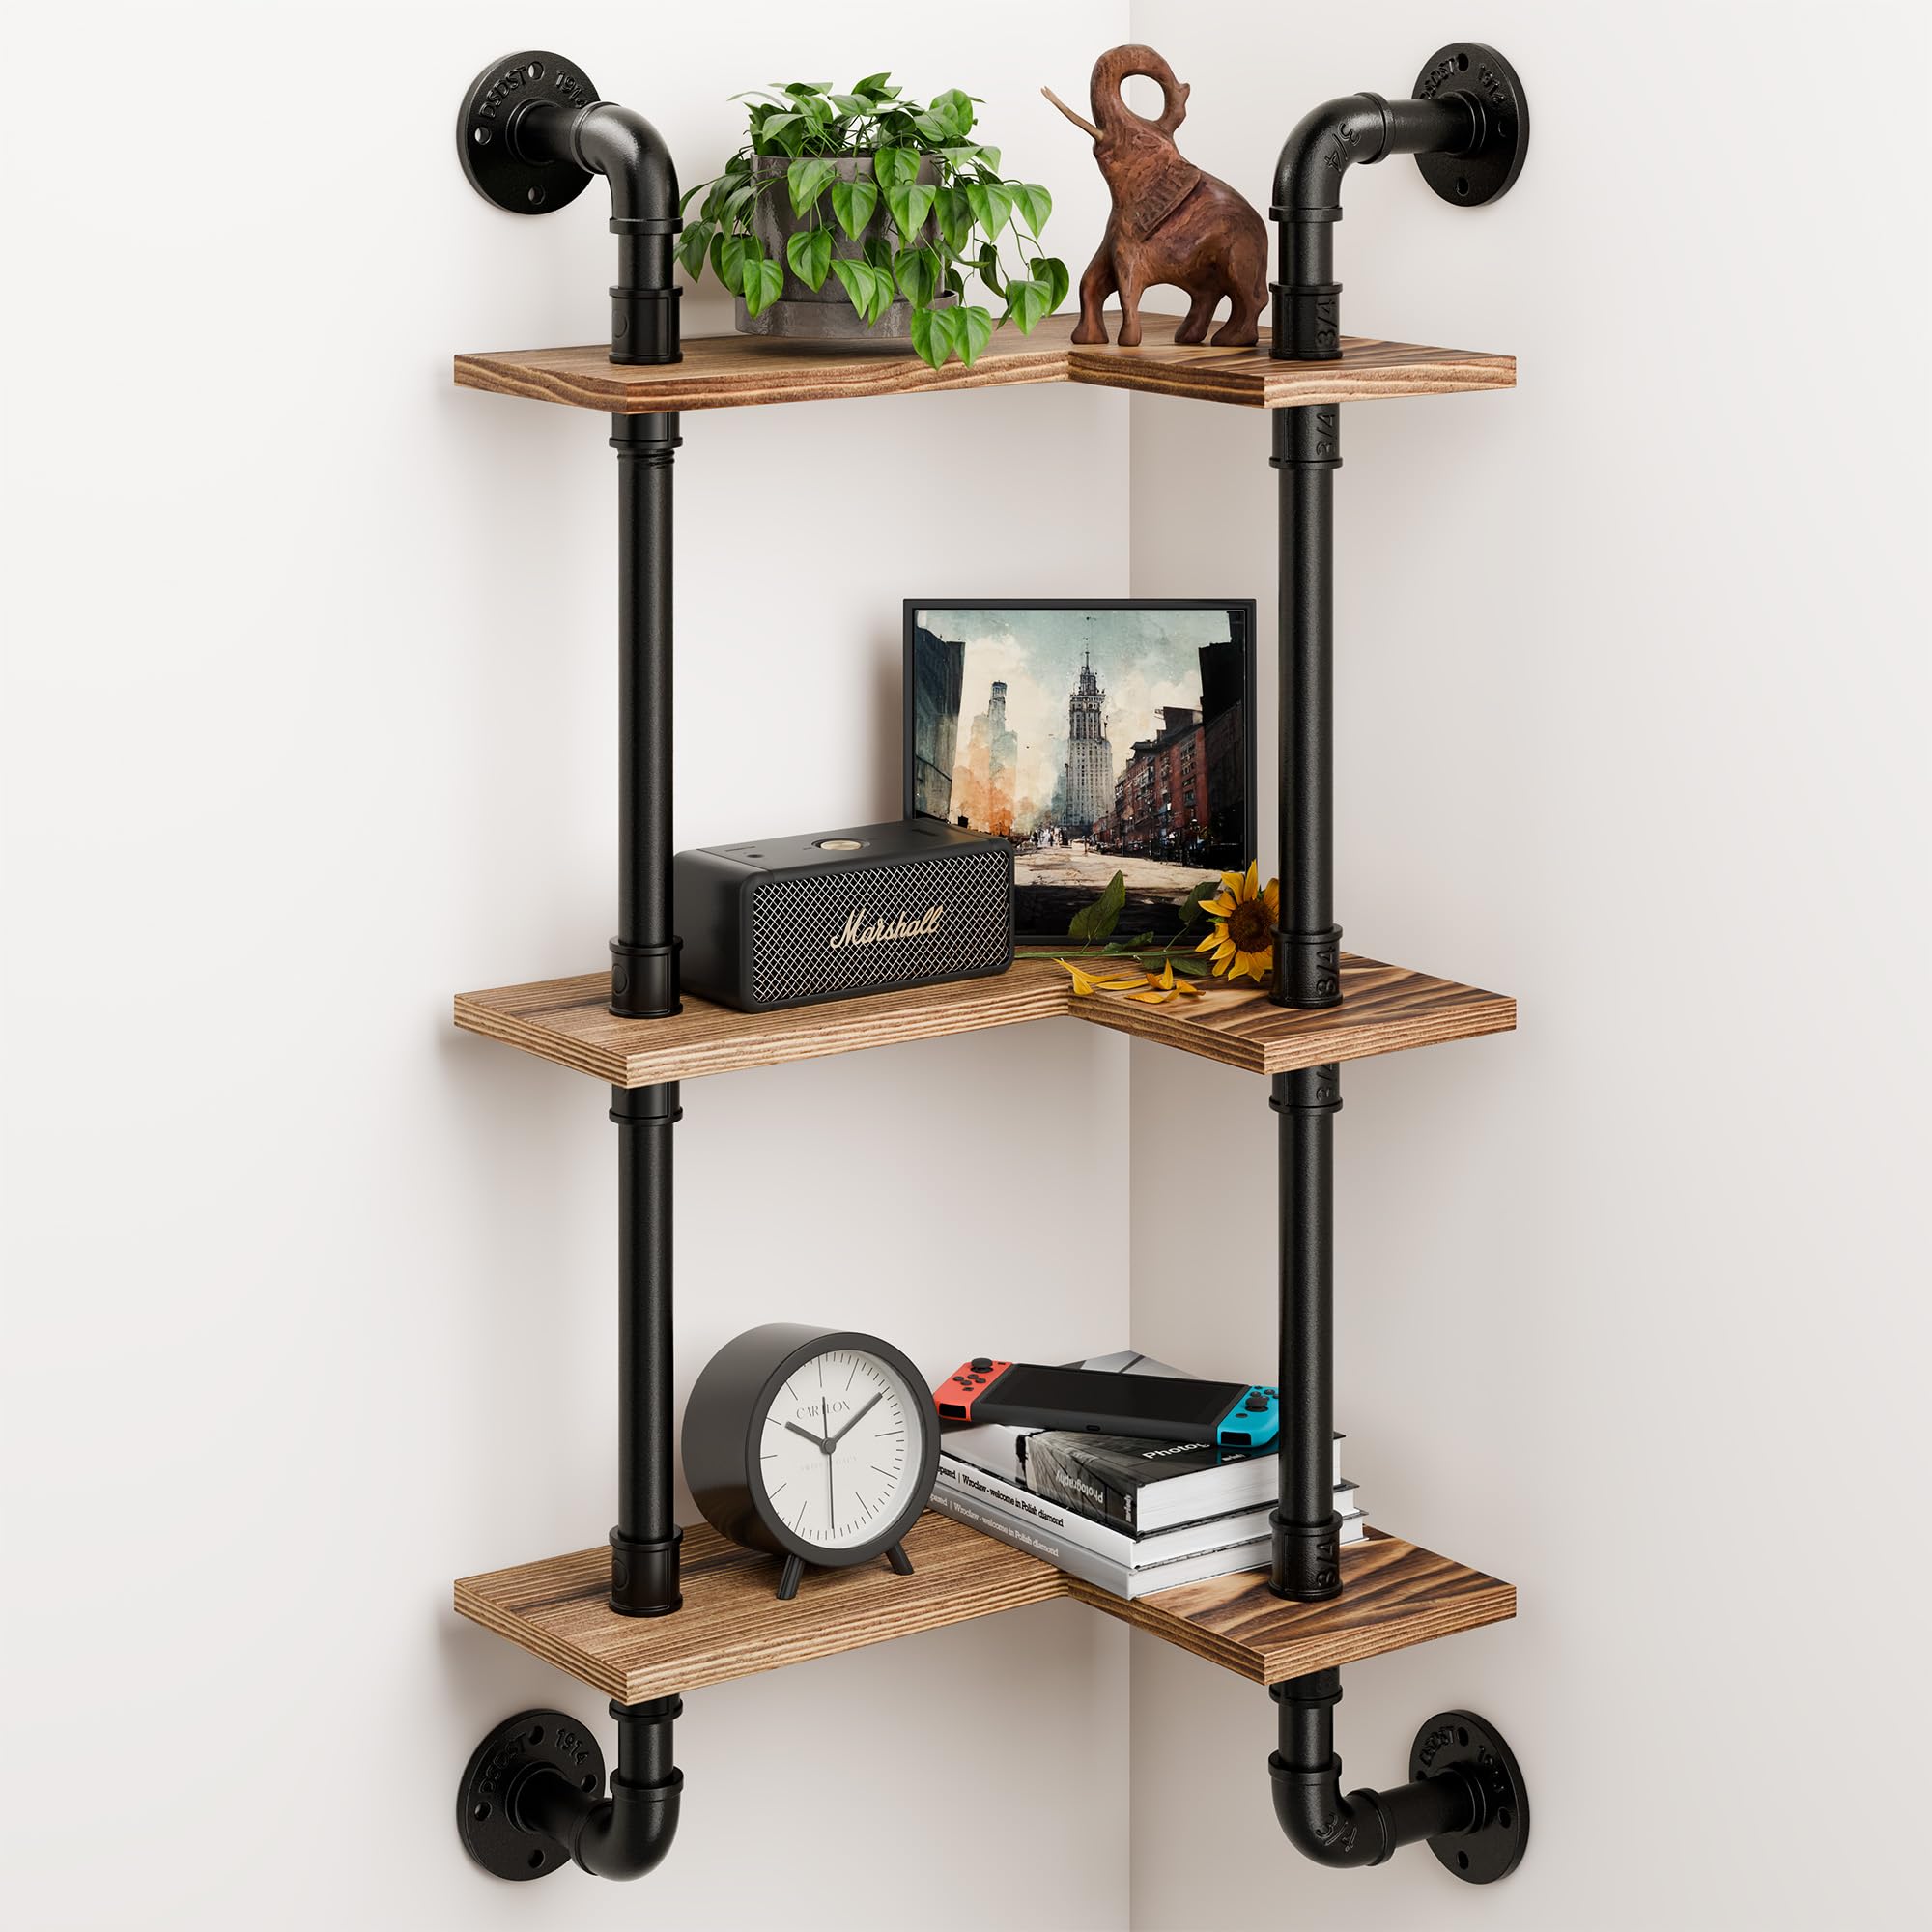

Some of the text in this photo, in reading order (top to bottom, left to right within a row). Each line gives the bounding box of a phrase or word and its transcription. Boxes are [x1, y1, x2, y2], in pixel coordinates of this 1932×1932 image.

[1323, 122, 1362, 172] 3/4
[1316, 298, 1338, 348] 3/4
[830, 904, 944, 949] Marshall
[1316, 946, 1337, 996] 3/4
[990, 1488, 1015, 1506] welcome
[1022, 1501, 1037, 1517] Polish
[1038, 1510, 1064, 1528] diamond
[1056, 1470, 1104, 1504] Photography
